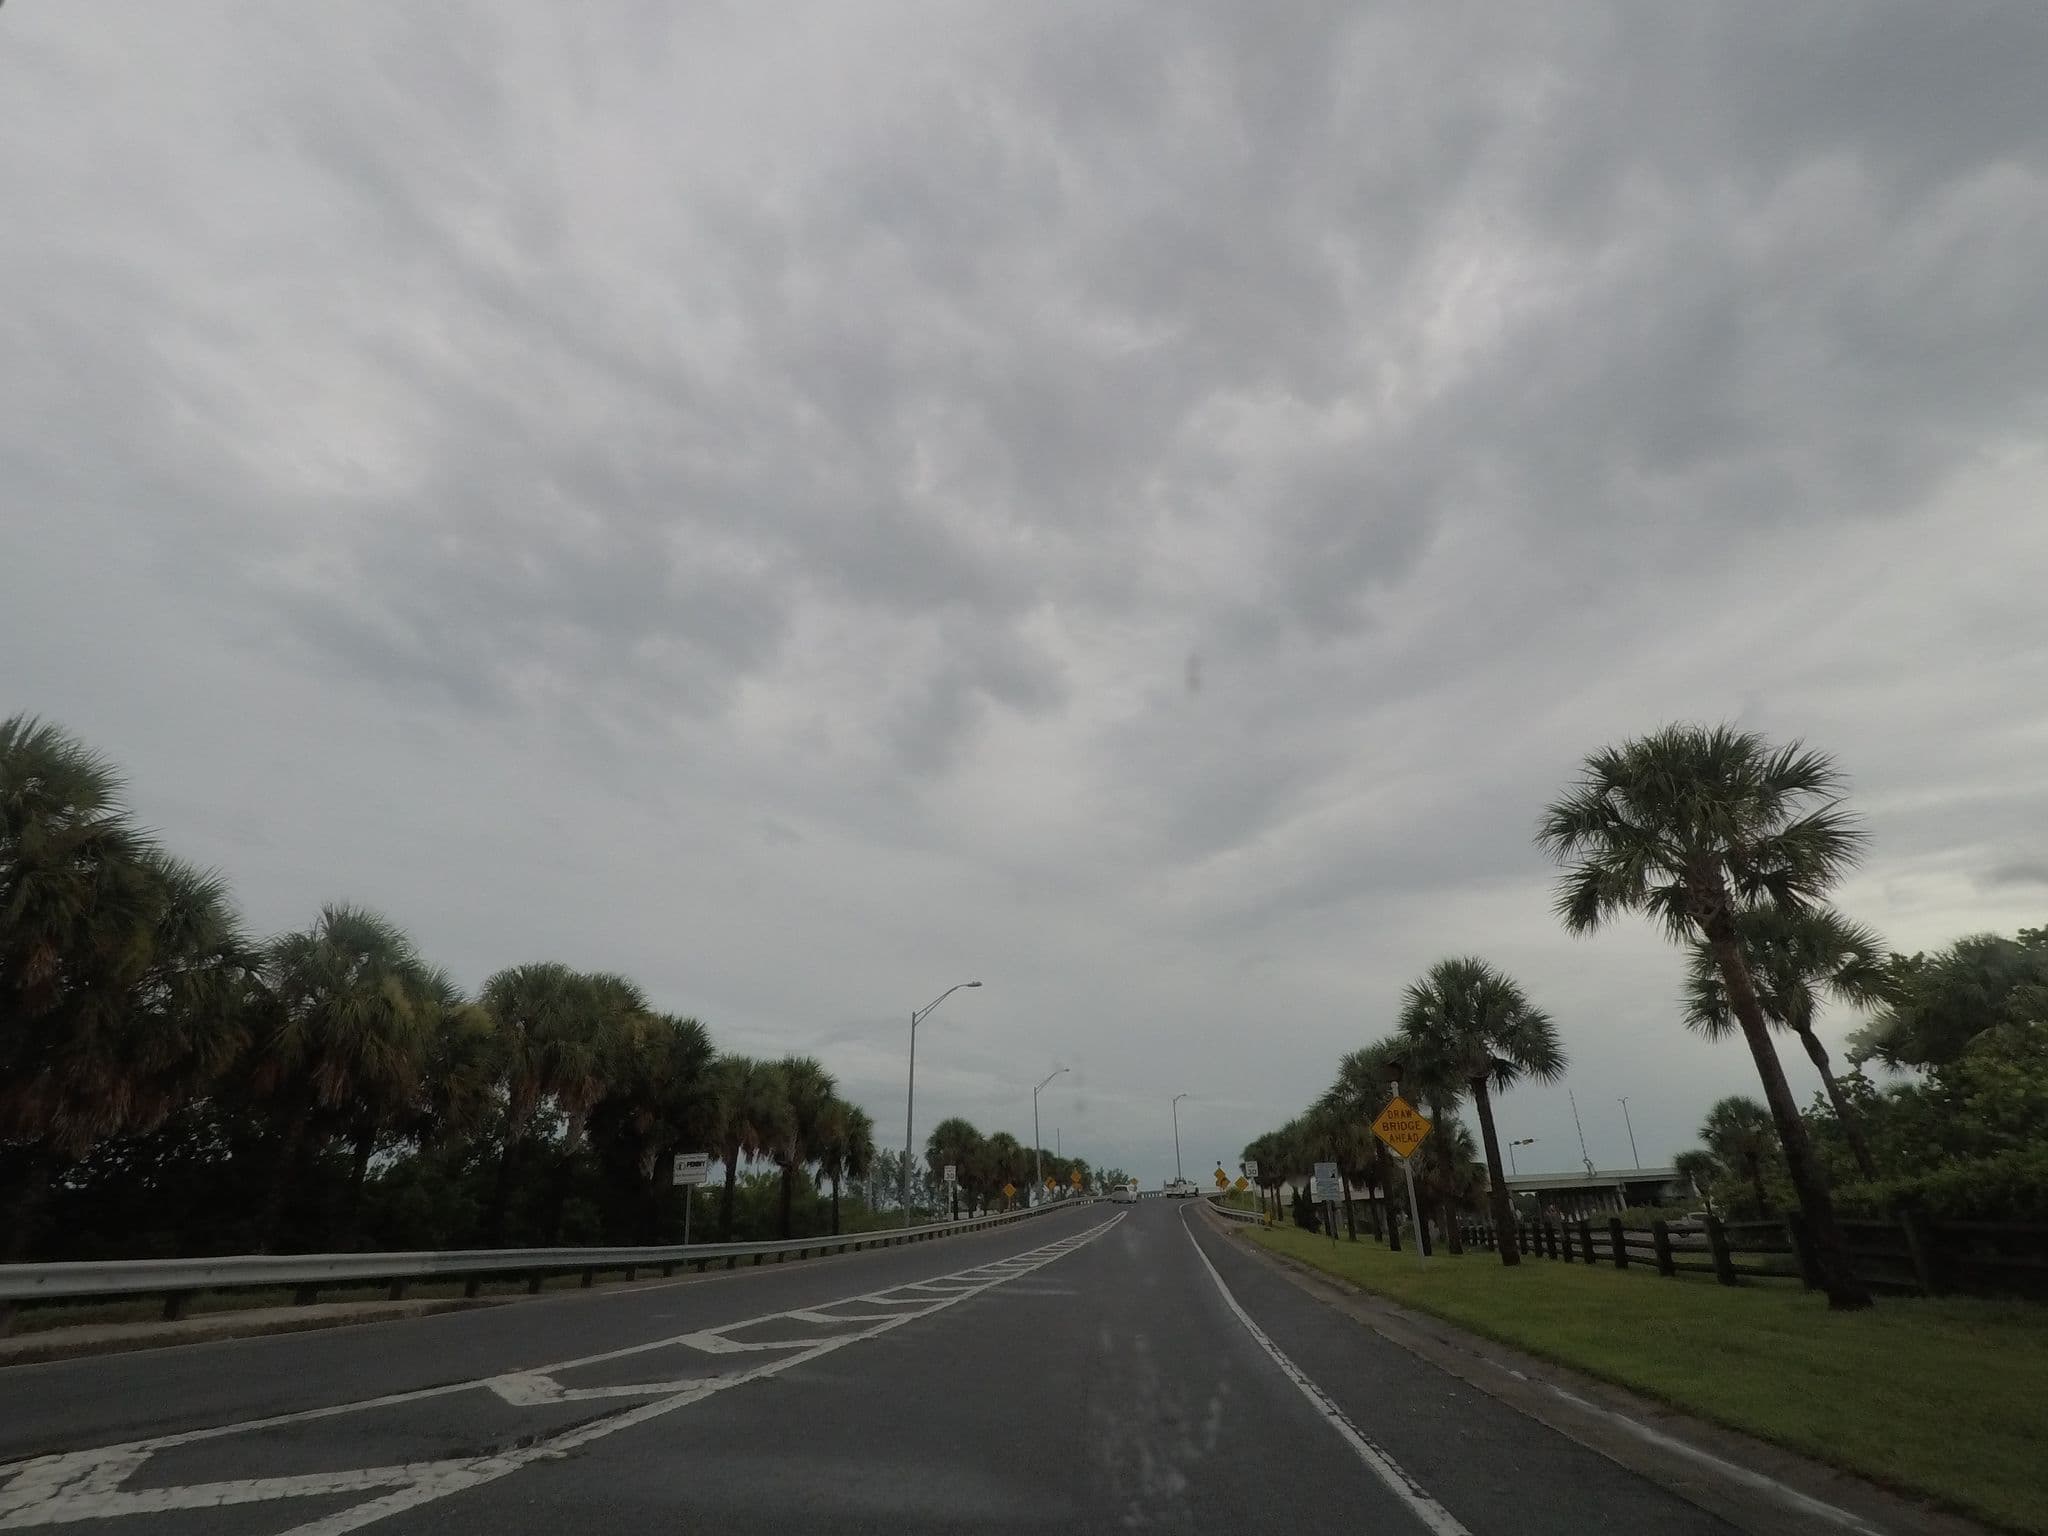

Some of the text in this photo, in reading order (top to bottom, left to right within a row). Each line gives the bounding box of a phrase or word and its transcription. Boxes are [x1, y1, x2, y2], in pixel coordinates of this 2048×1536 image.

[1387, 1110, 1412, 1119] DRAW
[1382, 1121, 1421, 1131] BRIDGE
[1389, 1133, 1419, 1143] AHEAD
